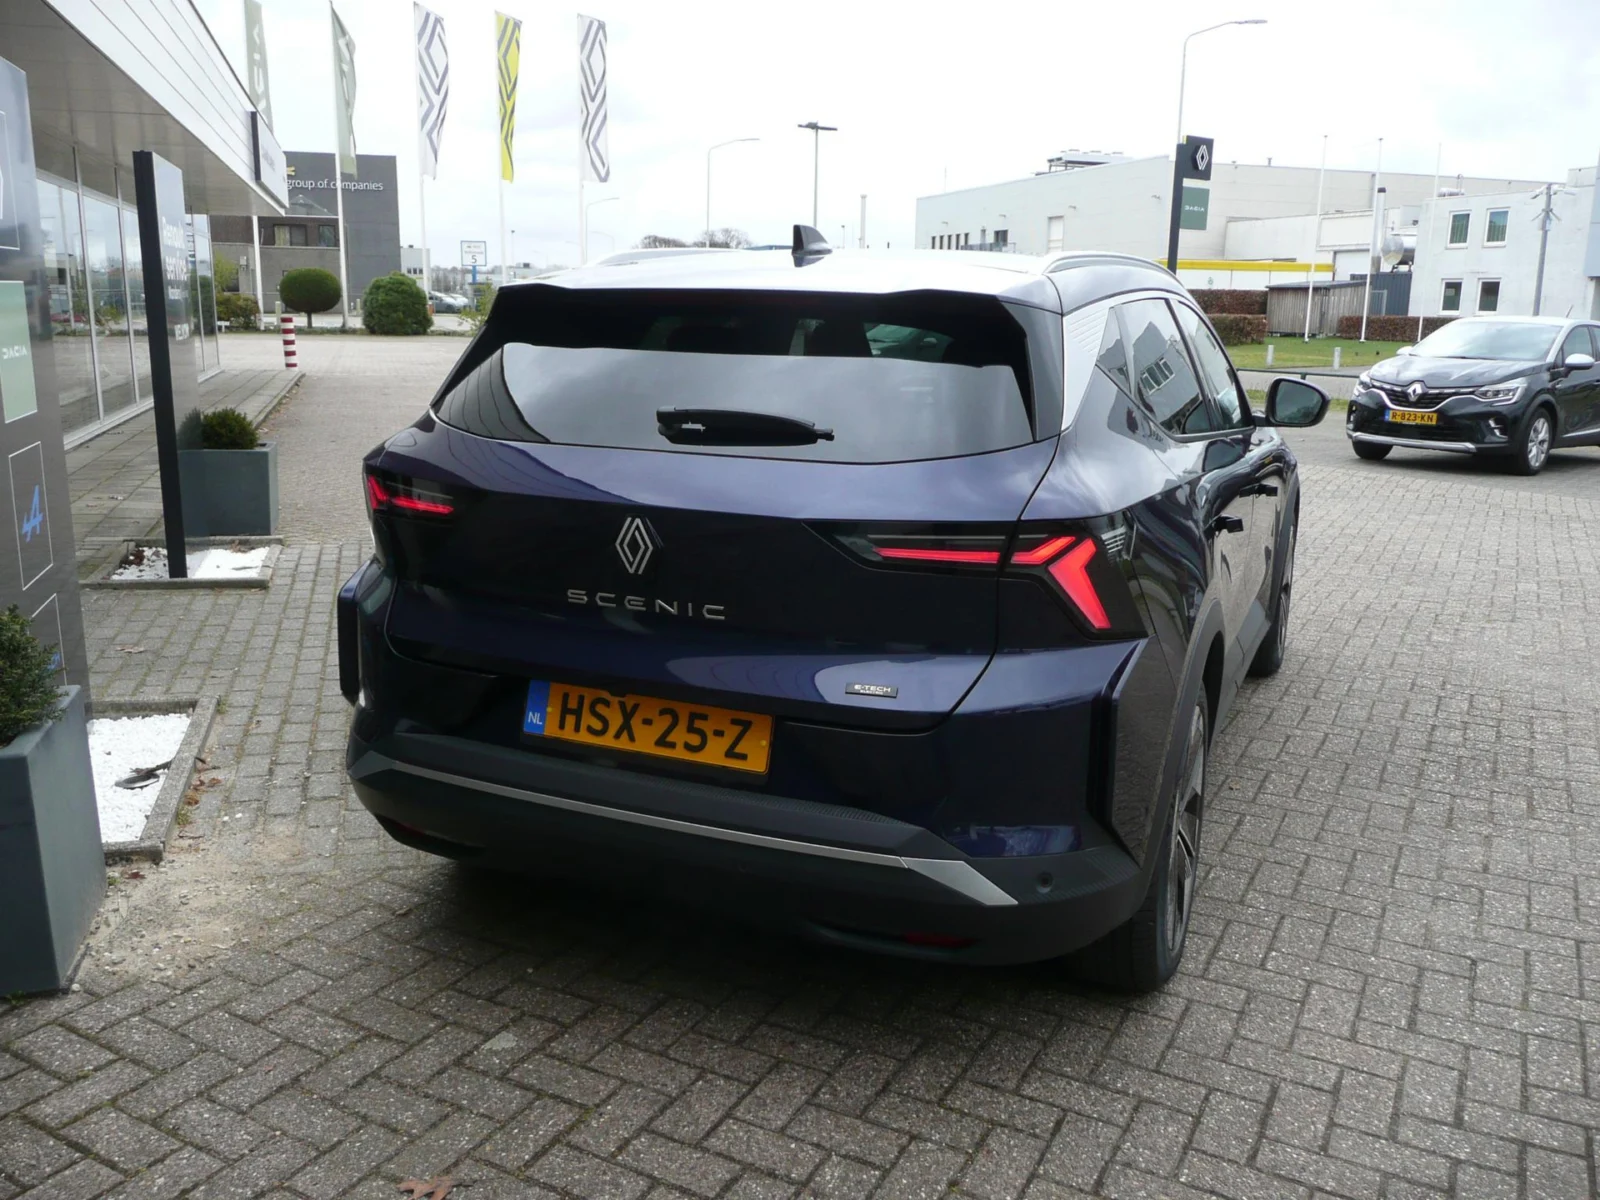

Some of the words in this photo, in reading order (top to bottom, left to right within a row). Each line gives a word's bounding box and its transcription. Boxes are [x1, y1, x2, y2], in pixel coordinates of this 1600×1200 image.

[287, 179, 315, 191] group
[317, 178, 329, 189] of
[330, 180, 384, 192] cmpanies
[1184, 205, 1205, 213] DACIA
[471, 254, 478, 264] 5
[1392, 412, 1434, 423] R-823-KN
[567, 588, 726, 621] SCENIC
[854, 684, 891, 693] E-TECH
[528, 711, 543, 725] NL
[558, 692, 753, 760] HSX-25-Z
